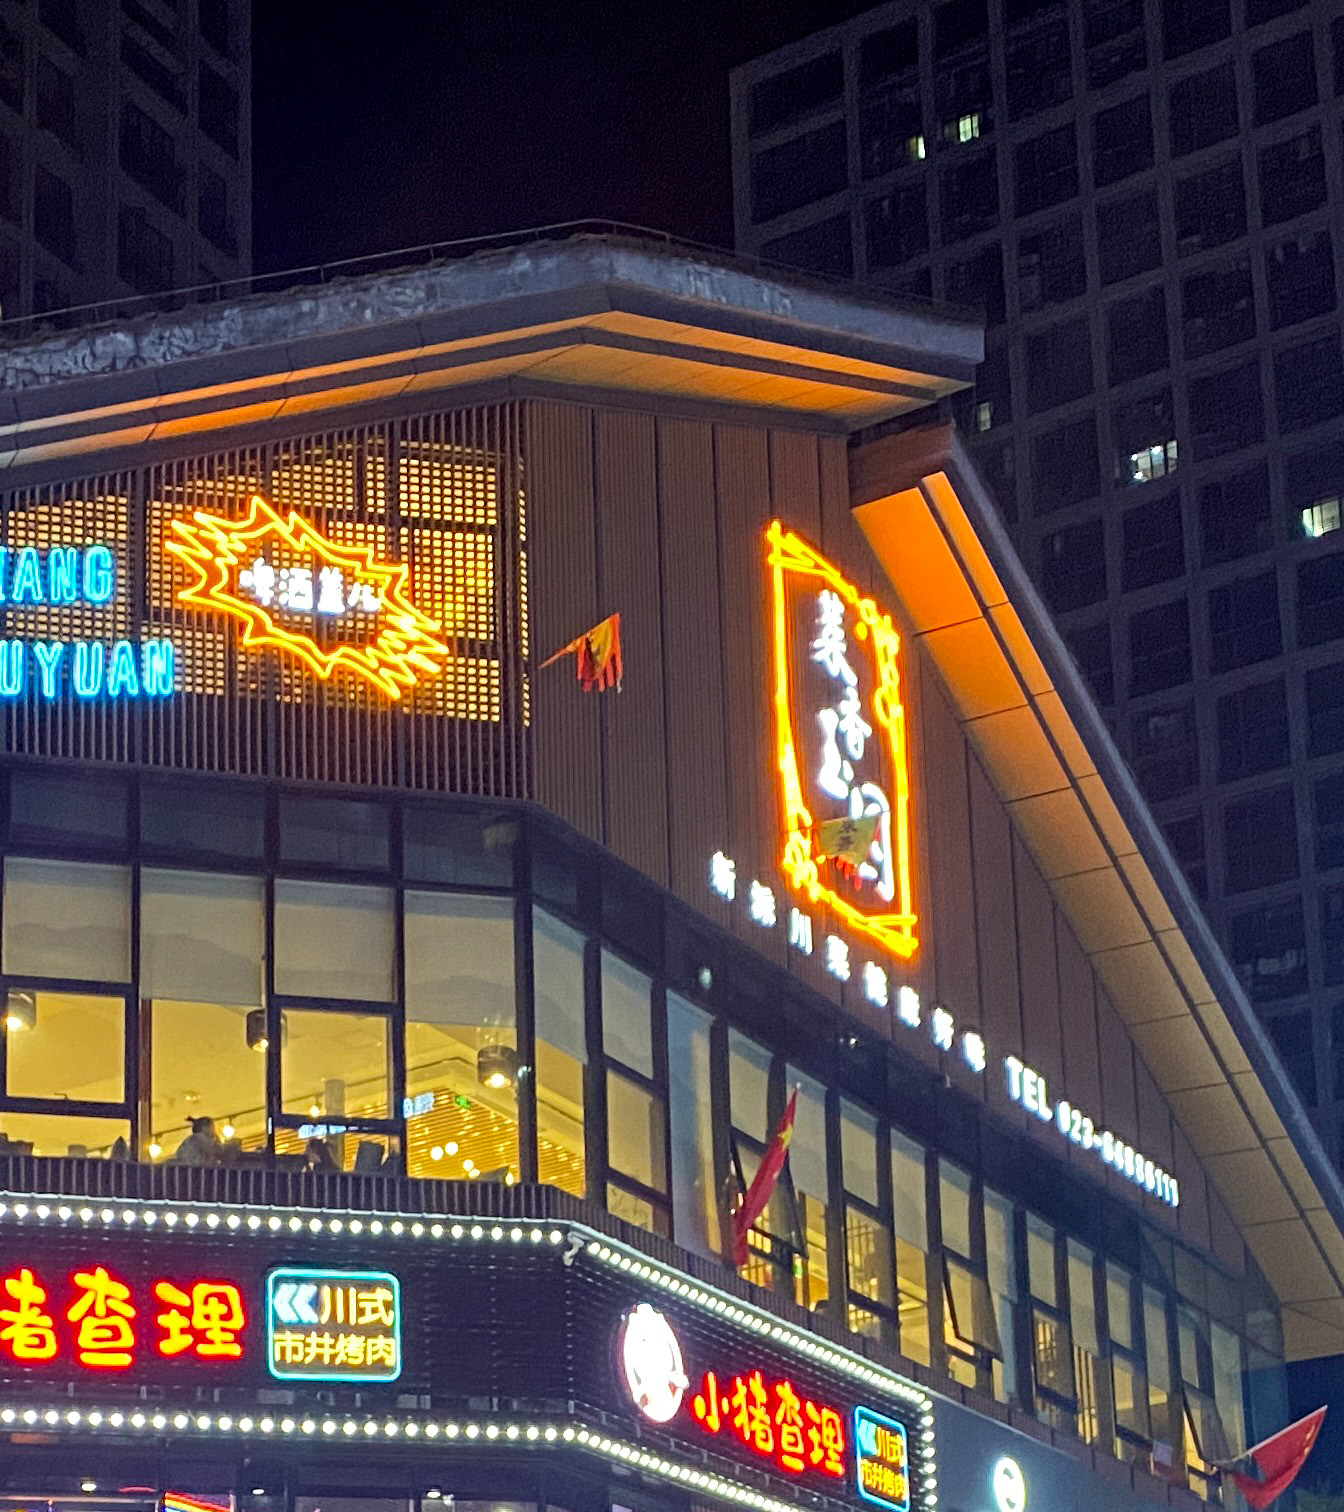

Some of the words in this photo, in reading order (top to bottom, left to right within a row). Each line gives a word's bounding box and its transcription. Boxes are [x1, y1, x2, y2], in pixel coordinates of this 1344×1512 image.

[1005, 1055, 1054, 1122] TEL
[318, 1286, 397, 1327] 川式
[272, 1331, 398, 1369] 市井烤肉
[693, 1369, 846, 1477] 小猪查理
[874, 1424, 907, 1467] 川式
